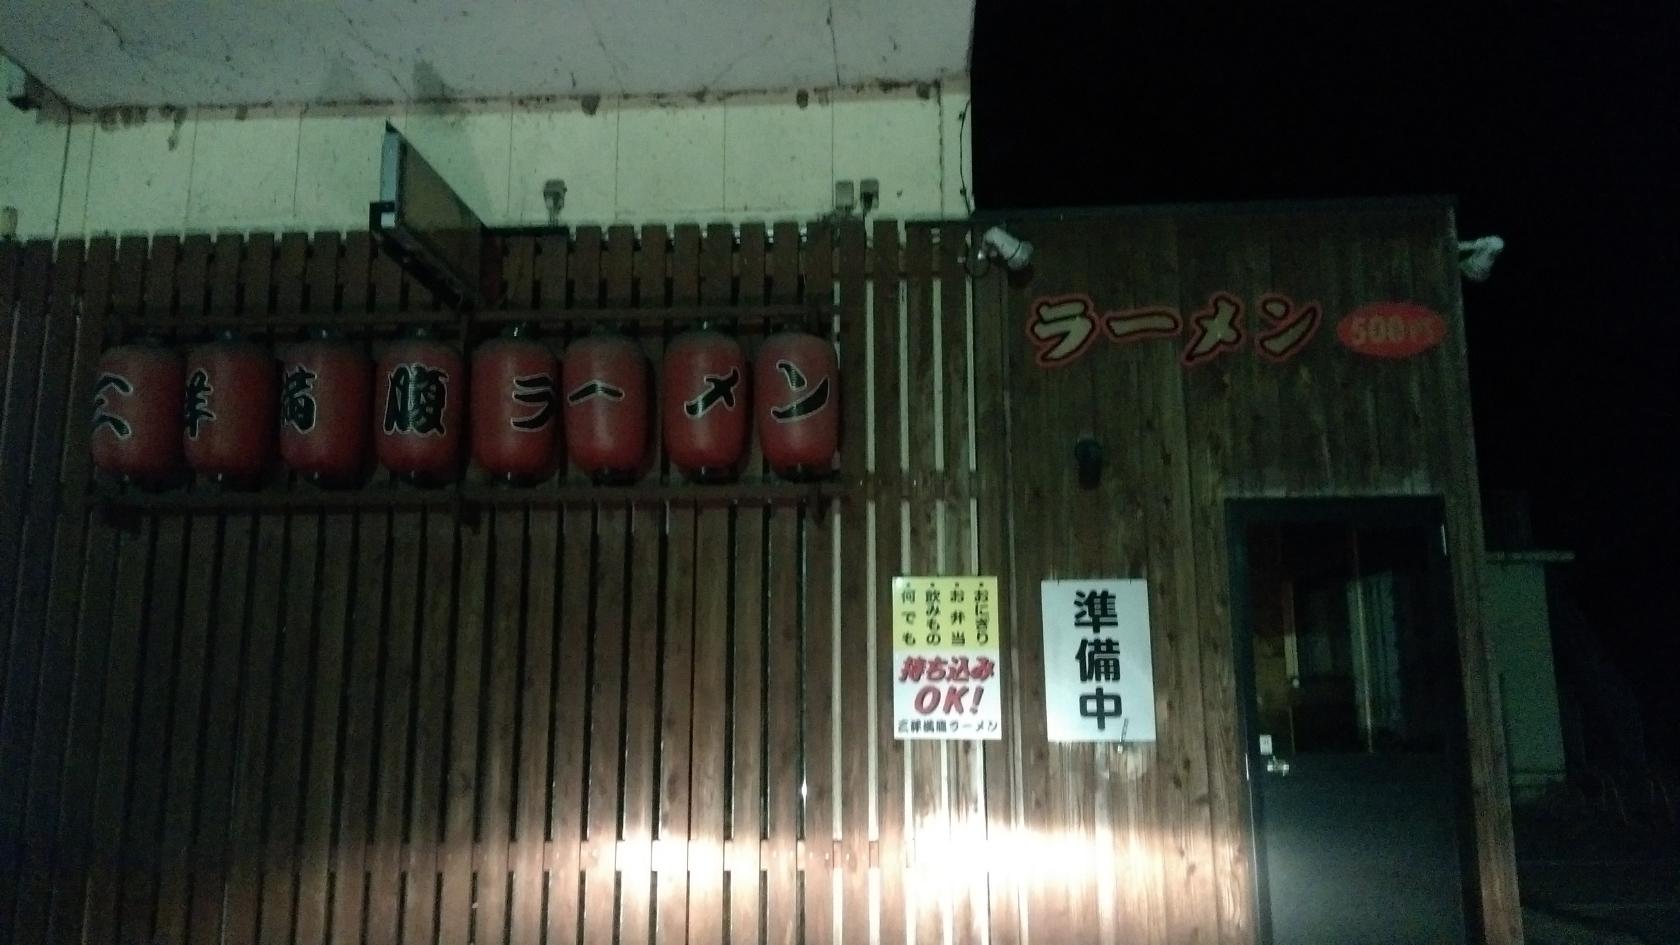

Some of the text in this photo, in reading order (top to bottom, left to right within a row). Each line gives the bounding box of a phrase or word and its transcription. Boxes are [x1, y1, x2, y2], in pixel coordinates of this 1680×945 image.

[1027, 291, 1323, 367] ラーメン
[901, 589, 917, 646] 何でも
[925, 589, 942, 646] 飲みもの
[949, 589, 966, 646] お弁当
[973, 589, 991, 646] おにぎり
[898, 655, 995, 683] 持ち込み
[1073, 589, 1123, 731] 準備中
[913, 686, 985, 716] OK!
